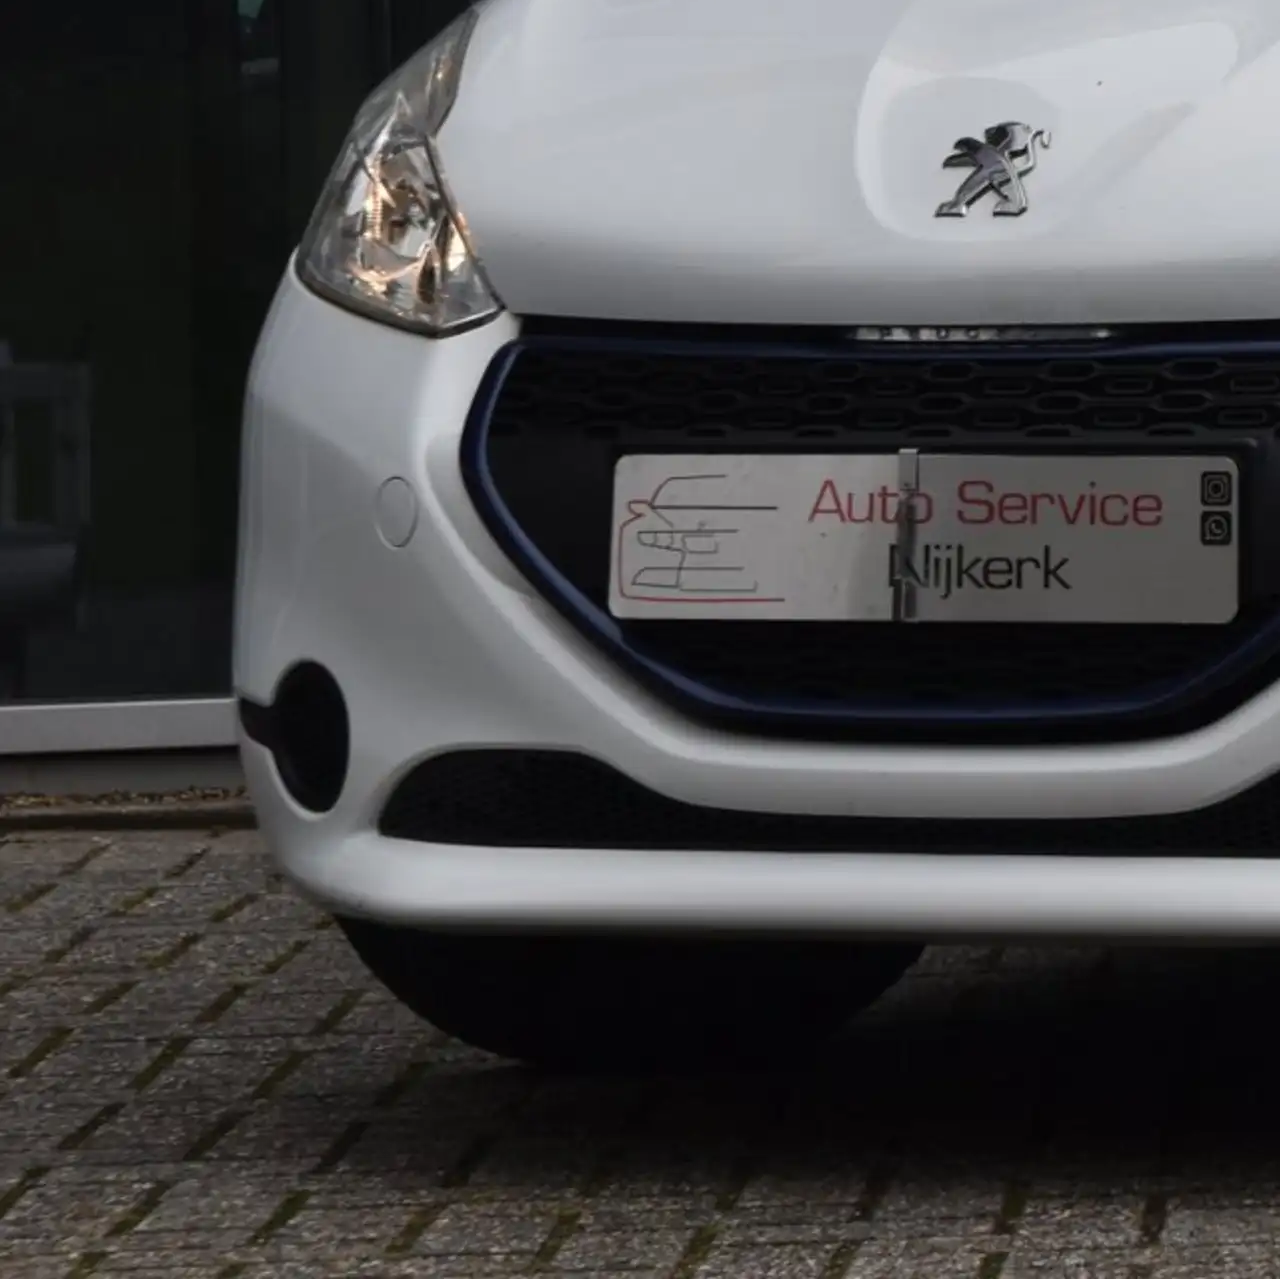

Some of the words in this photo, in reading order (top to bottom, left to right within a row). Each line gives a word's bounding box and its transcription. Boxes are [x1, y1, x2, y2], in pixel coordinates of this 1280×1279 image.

[807, 479, 933, 525] Auto
[957, 480, 1163, 526] Service
[888, 543, 1072, 600] Nijkerk
